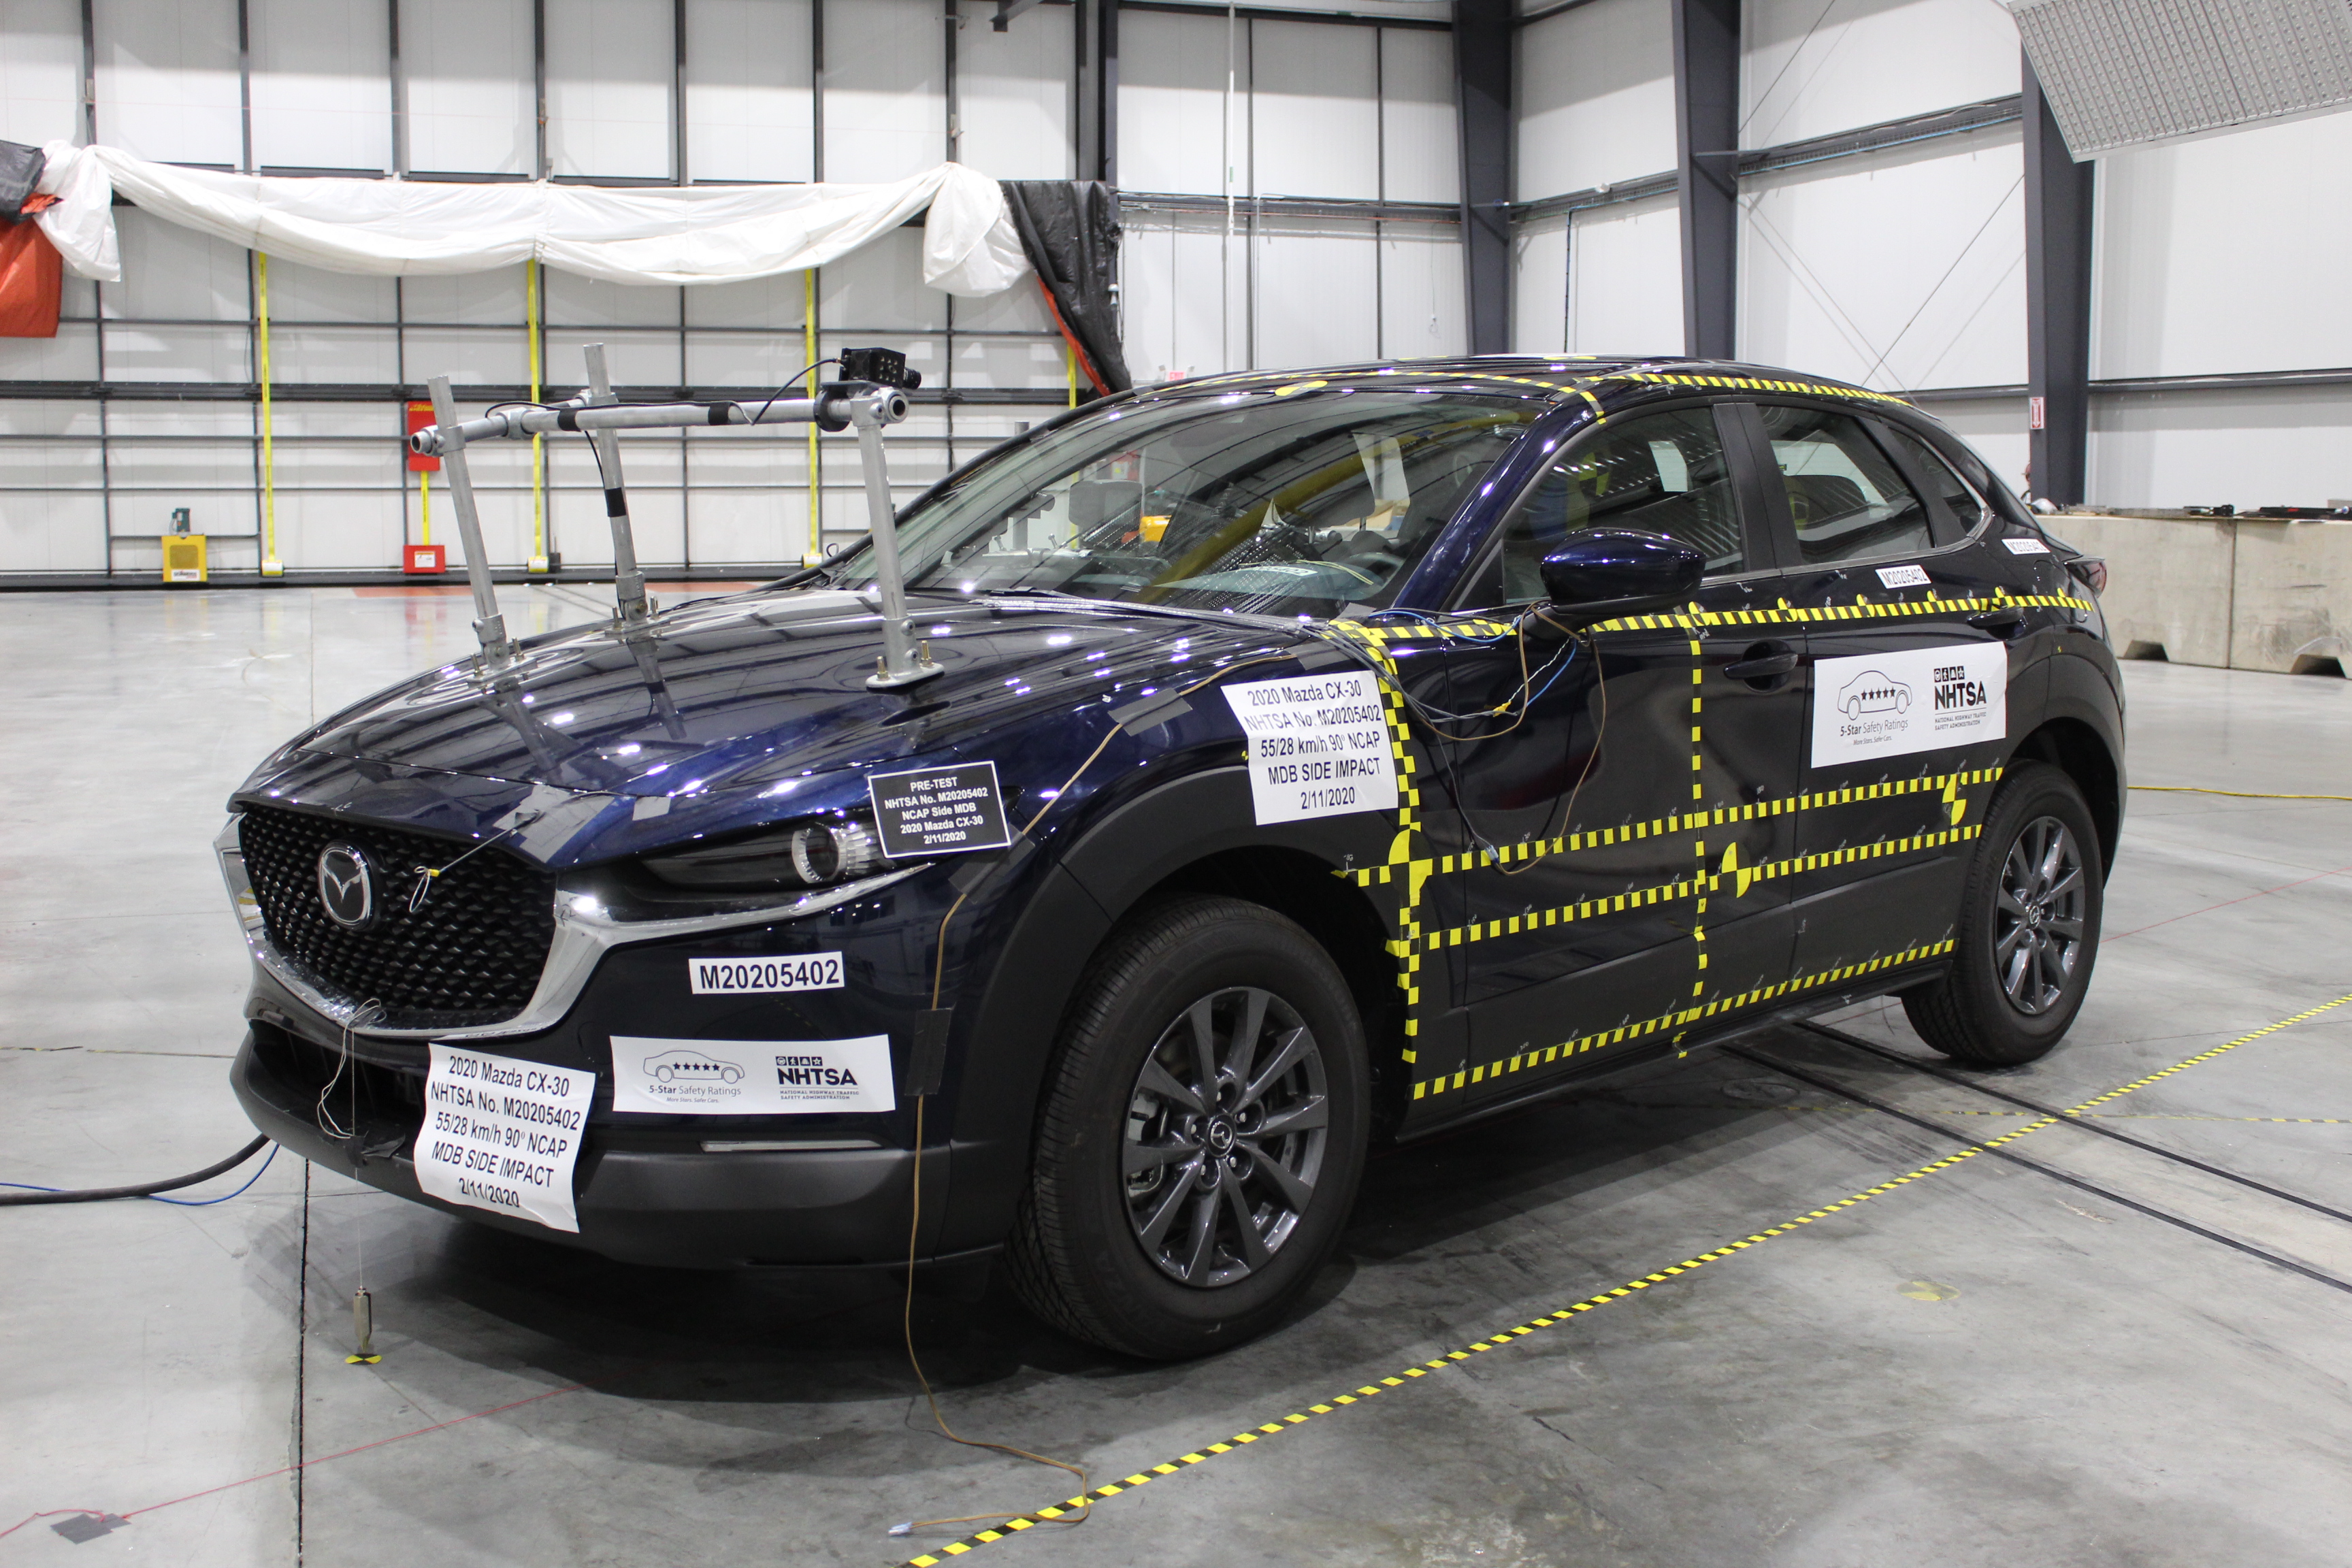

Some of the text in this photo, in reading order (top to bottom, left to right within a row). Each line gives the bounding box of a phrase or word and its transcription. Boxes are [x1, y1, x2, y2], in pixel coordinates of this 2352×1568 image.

[1880, 568, 1928, 585] M20205402
[1247, 680, 1362, 706] 2020 Mazda CX-30
[1934, 681, 1987, 710] NHTSA
[1243, 704, 1382, 731] NHTSA No. M20205402
[1840, 719, 1908, 736] 5-Star Safety Ratings
[1949, 719, 1980, 729] ADMINISTRATION
[1261, 737, 1294, 757] 55/28
[1298, 736, 1328, 755] km/h
[1348, 731, 1380, 749] NCAP
[1268, 757, 1381, 785] MDB SIDE IMPACT
[910, 777, 958, 792] PRE-TEST
[884, 787, 988, 809] NHTSA No. M20205402
[1301, 786, 1356, 810] 2/11/2020
[902, 802, 977, 821] NCAP Side MDB
[900, 815, 983, 834] 2020 Mazda CX-30
[924, 830, 966, 845] 2/11/2020
[699, 959, 839, 989] M20205402
[448, 1056, 570, 1097] 2020 Mazda CX-30
[777, 1067, 858, 1085] NHTSA
[649, 1085, 741, 1097] 5-Star Safety Ratings
[431, 1081, 581, 1131] NHTSA No. M20205402
[436, 1111, 468, 1136] 55/28
[470, 1119, 502, 1144] km/h
[527, 1131, 568, 1159] NCAP
[431, 1141, 554, 1188] MDB SIDE IMPACT
[459, 1177, 520, 1208] 2/11/2020
